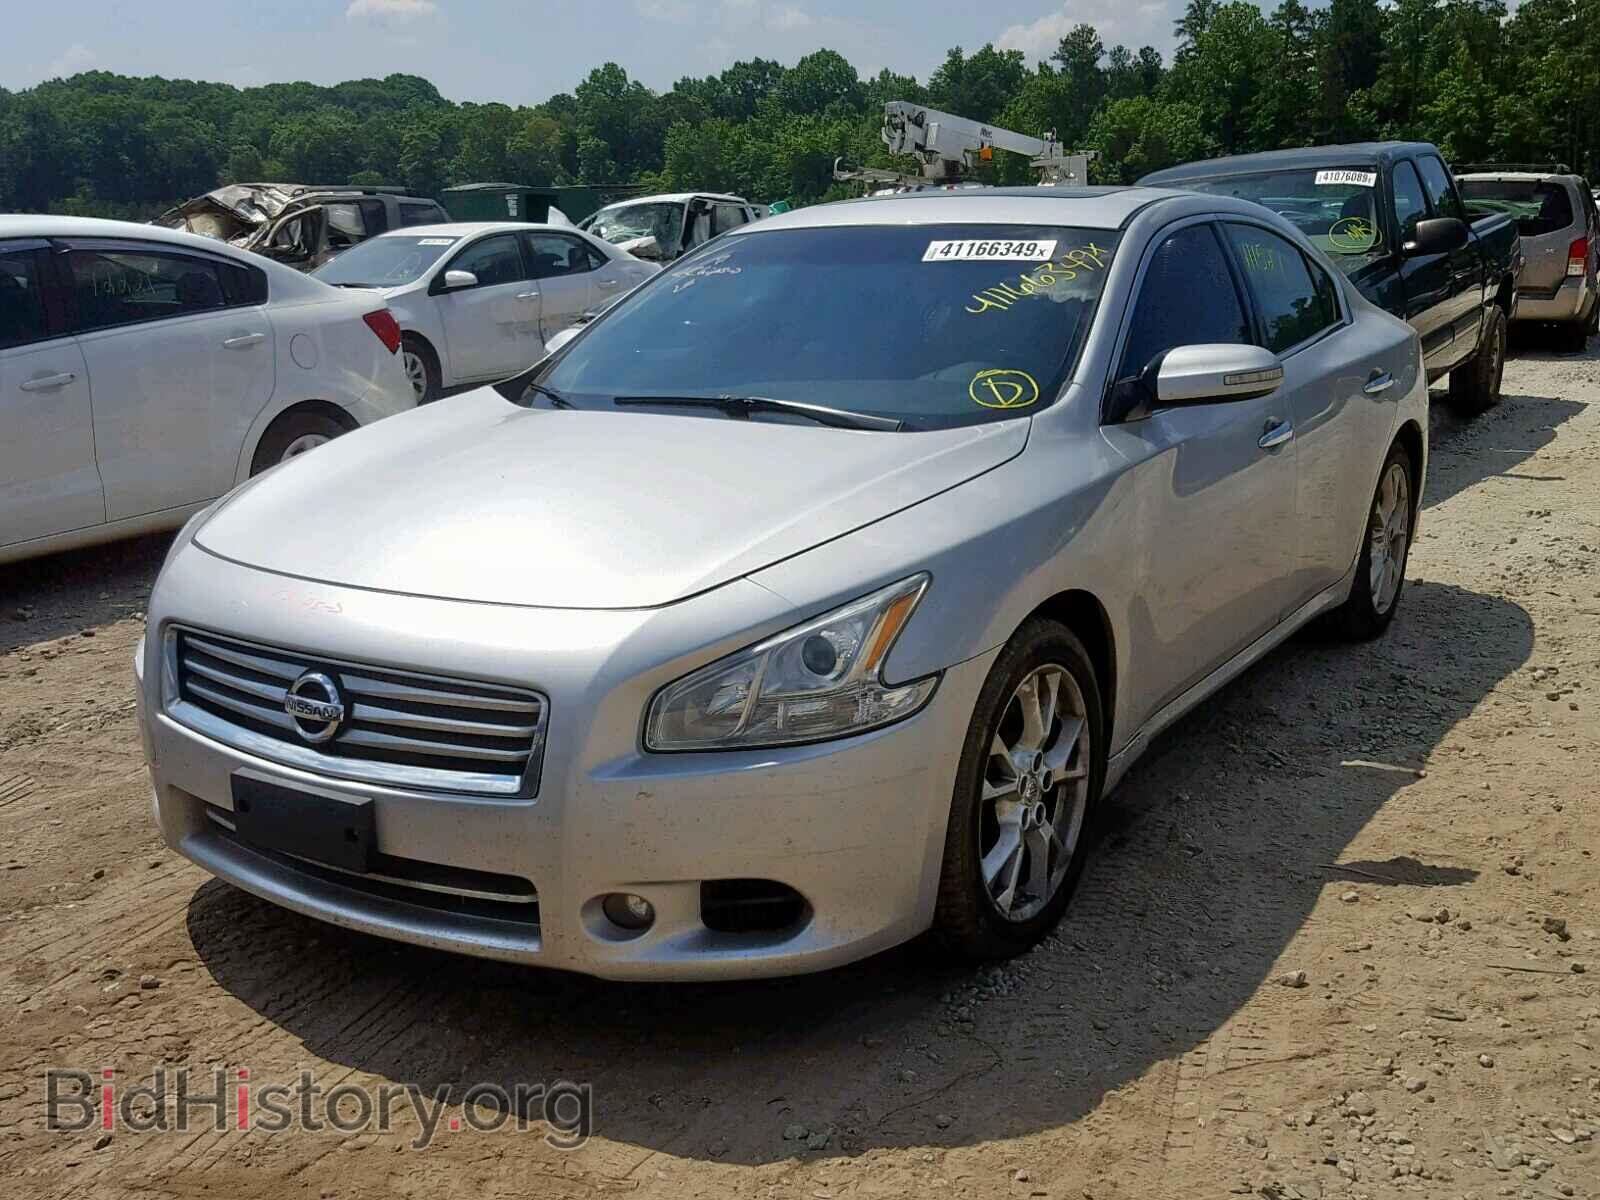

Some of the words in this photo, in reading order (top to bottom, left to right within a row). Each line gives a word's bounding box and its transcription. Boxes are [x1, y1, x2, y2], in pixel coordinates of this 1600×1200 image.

[939, 241, 1047, 257] 41166349x
[982, 378, 1024, 406] D
[287, 697, 338, 718] NISSAN
